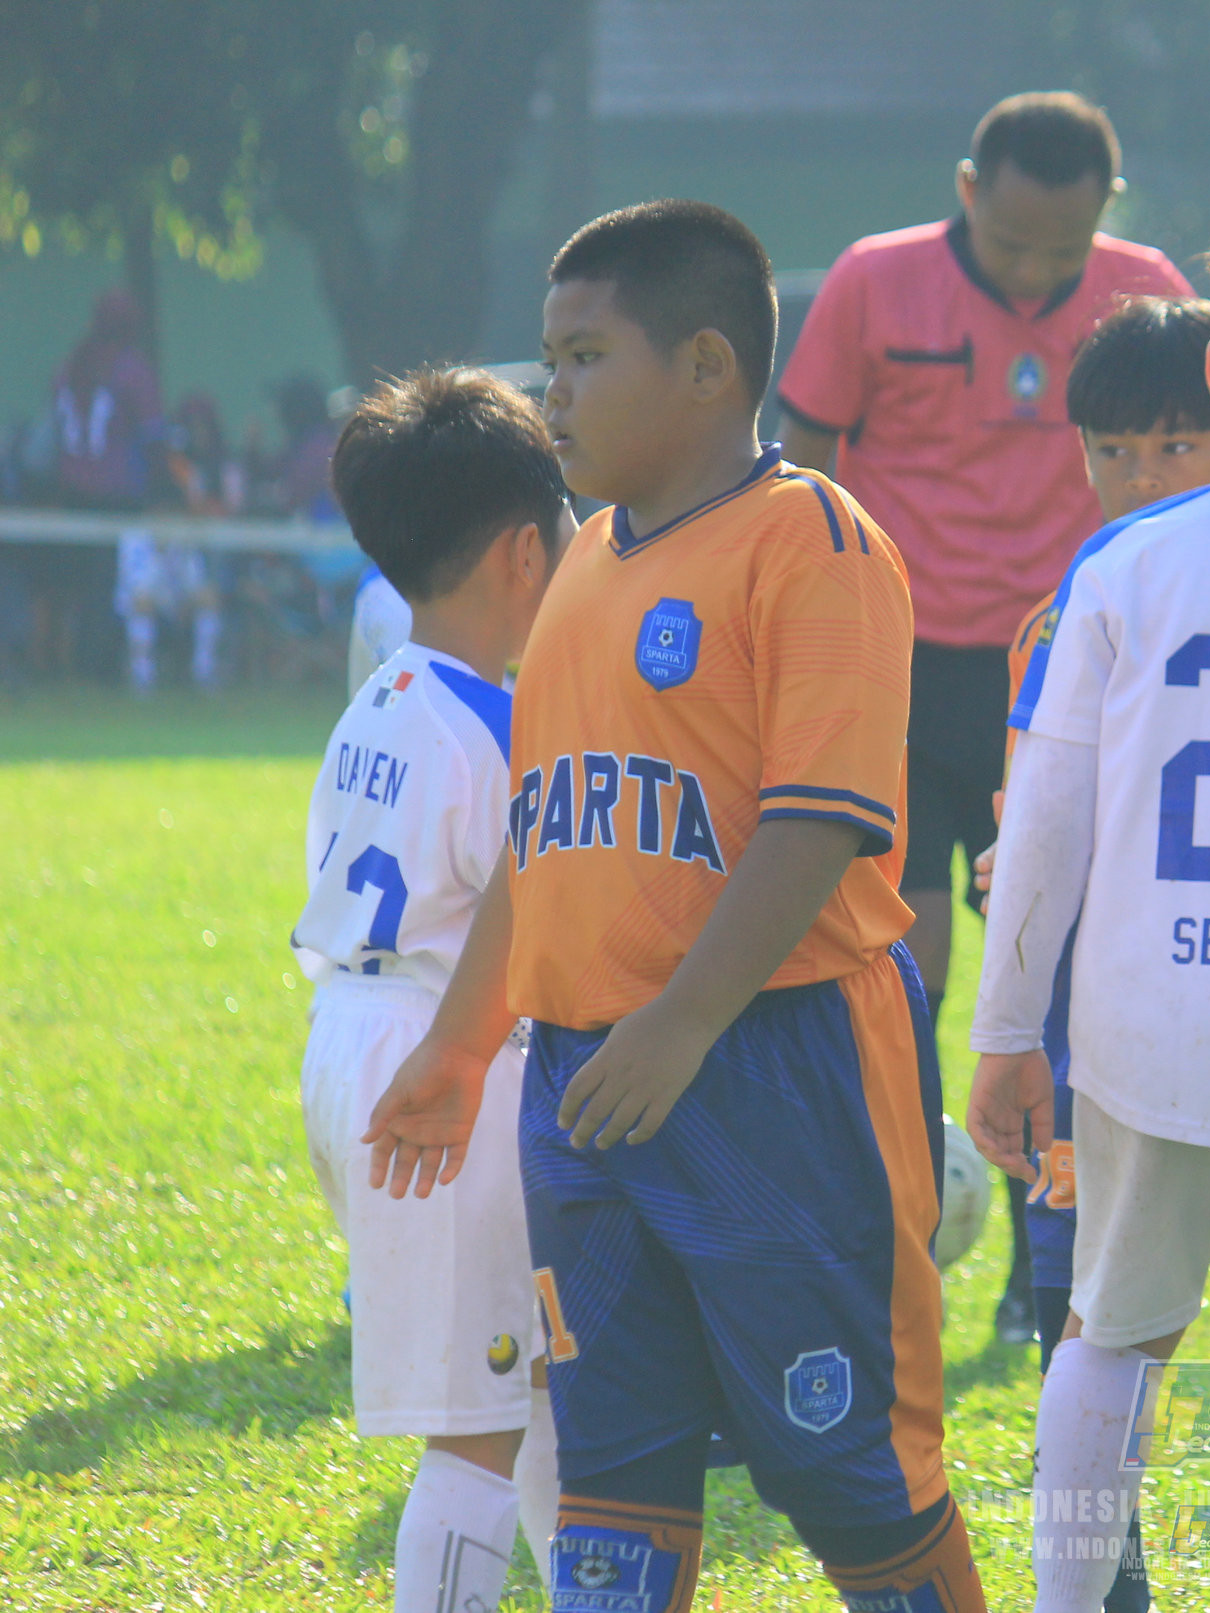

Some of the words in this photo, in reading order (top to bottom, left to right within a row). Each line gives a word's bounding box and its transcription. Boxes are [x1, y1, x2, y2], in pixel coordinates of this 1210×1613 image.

[645, 648, 681, 664] SPARTA
[651, 666, 669, 678] 1979
[336, 742, 408, 809] DAEN
